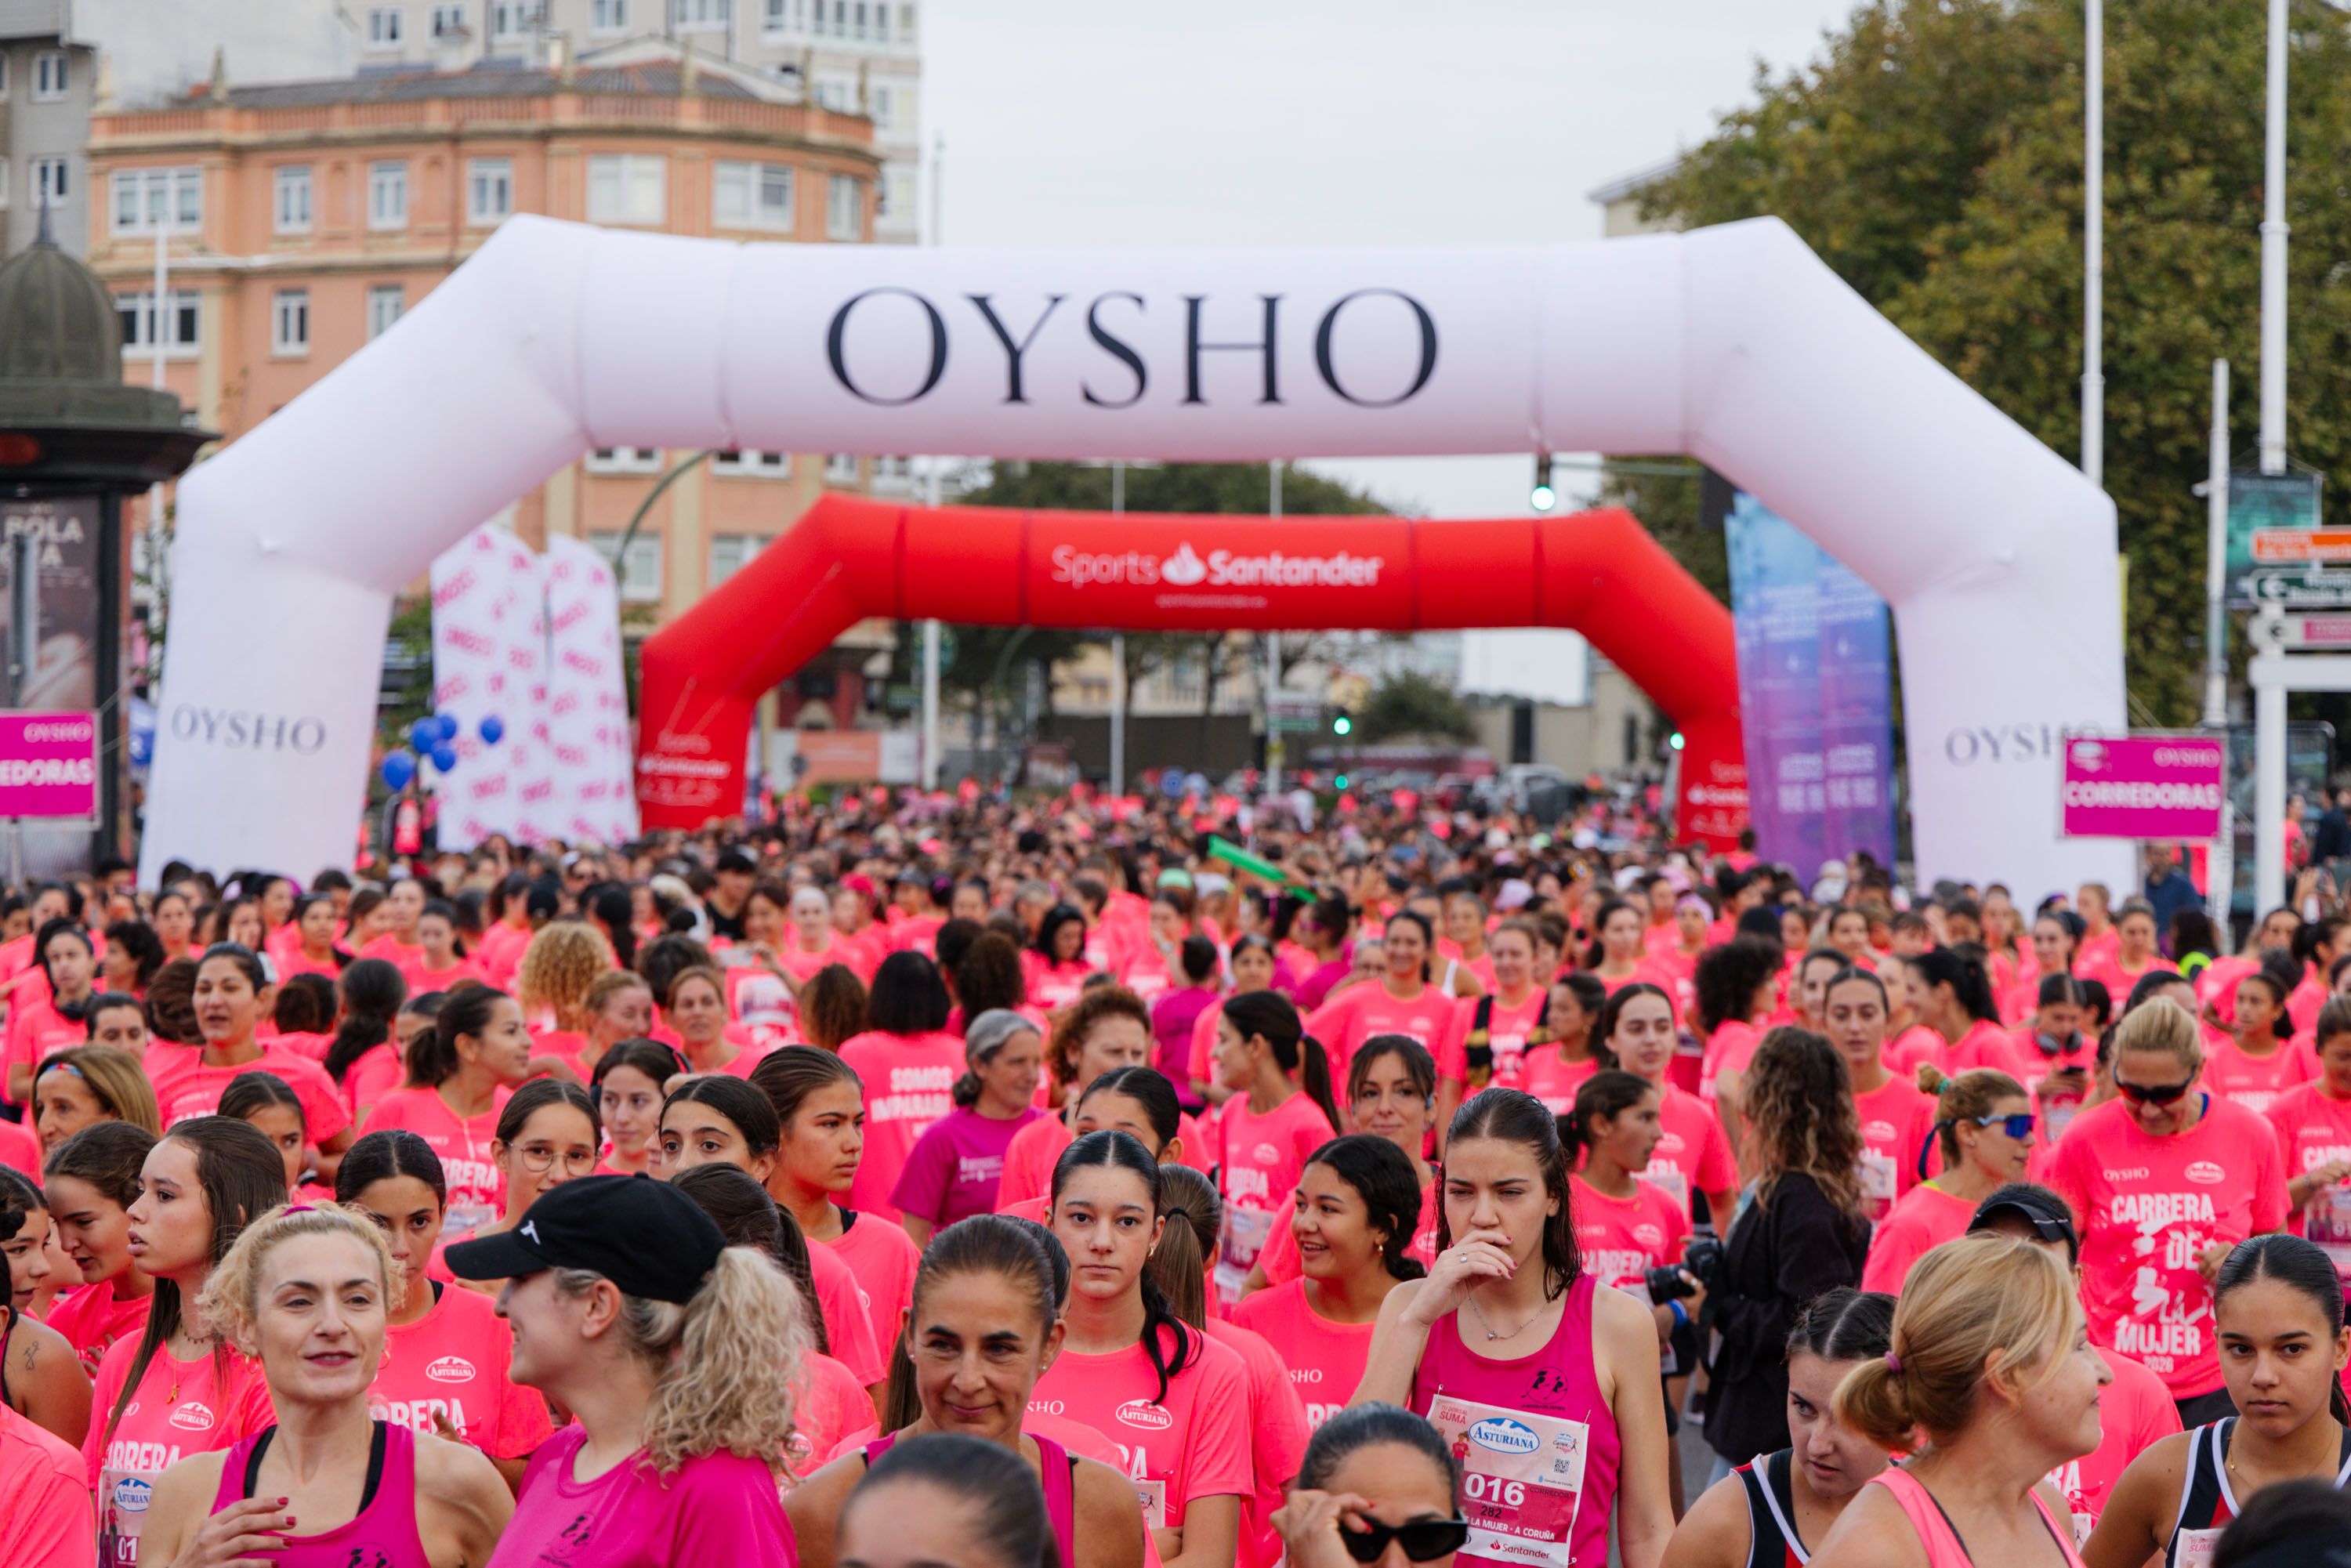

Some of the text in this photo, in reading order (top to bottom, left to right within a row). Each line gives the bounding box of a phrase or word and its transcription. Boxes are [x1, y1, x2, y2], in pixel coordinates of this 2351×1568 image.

[826, 286, 1440, 409] OYSHO
[1051, 544, 1385, 589] Sports Santander
[24, 721, 92, 743] OYSHO
[172, 704, 327, 755] OYSHO
[2153, 747, 2221, 768] OYSHO
[2064, 780, 2221, 810] CORREDORAS
[890, 1066, 954, 1092] SOMOS
[2103, 1167, 2150, 1182] OYSHO
[2111, 1192, 2216, 1223] CARRERA
[2114, 1322, 2201, 1356] MUJER
[1121, 1407, 1168, 1425] ASTURIANA
[1439, 1410, 1466, 1425] SUMA
[1473, 1425, 1534, 1449] ASTURIANA
[1465, 1474, 1525, 1506] 016
[1529, 1486, 1574, 1500] CORREDORA
[1480, 1505, 1502, 1519] 282
[1471, 1517, 1480, 1526] LA
[1483, 1519, 1508, 1531] MUJER
[1515, 1526, 1520, 1534] A
[1523, 1526, 1555, 1541] CORUÑA
[1502, 1544, 1550, 1559] Santander
